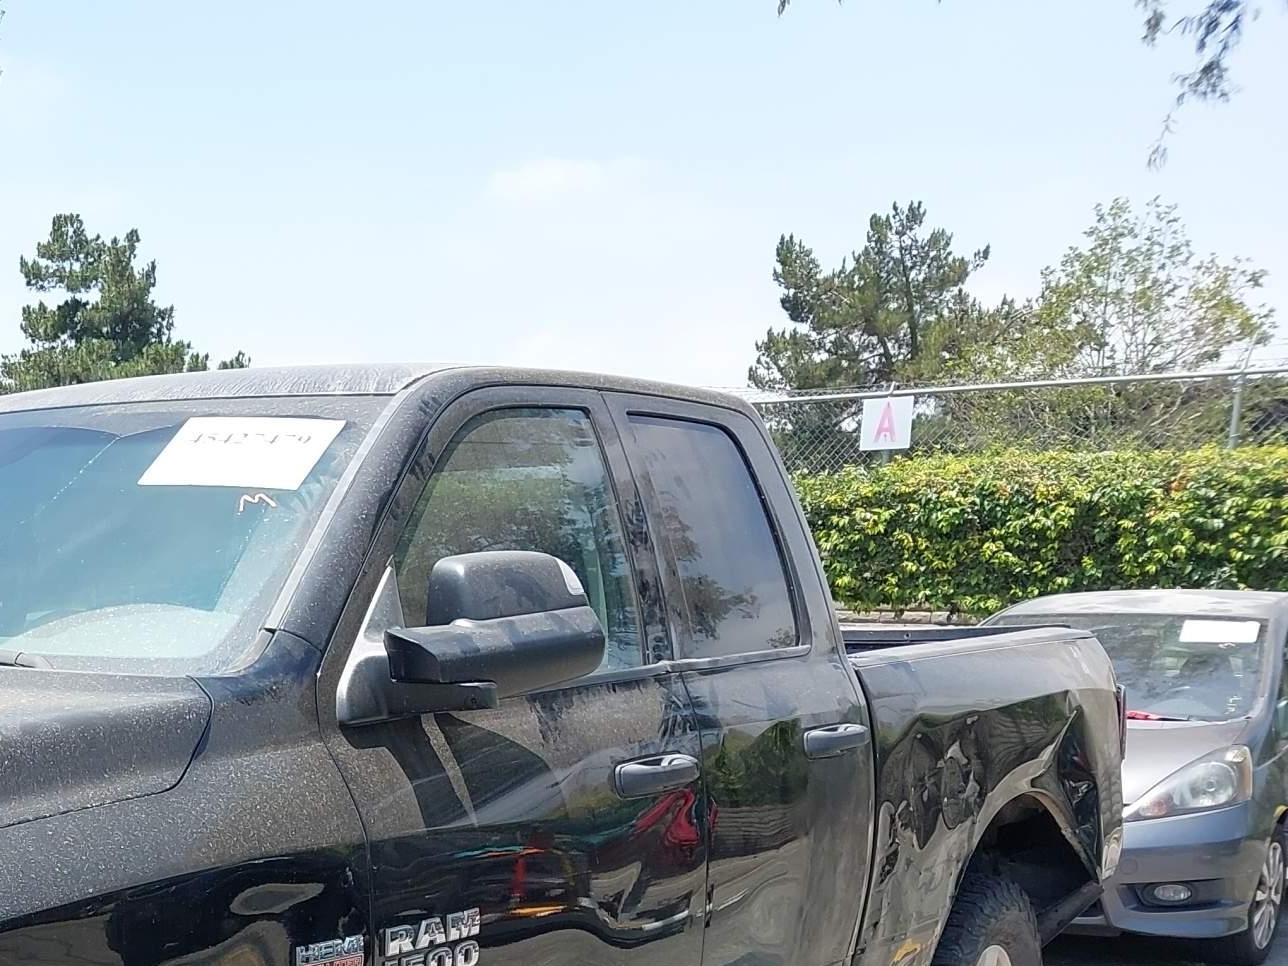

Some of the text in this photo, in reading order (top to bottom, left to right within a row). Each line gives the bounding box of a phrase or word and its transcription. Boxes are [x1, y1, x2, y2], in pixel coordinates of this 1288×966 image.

[873, 399, 897, 443] A
[296, 934, 364, 966] HEMI
[384, 907, 481, 957] RAM
